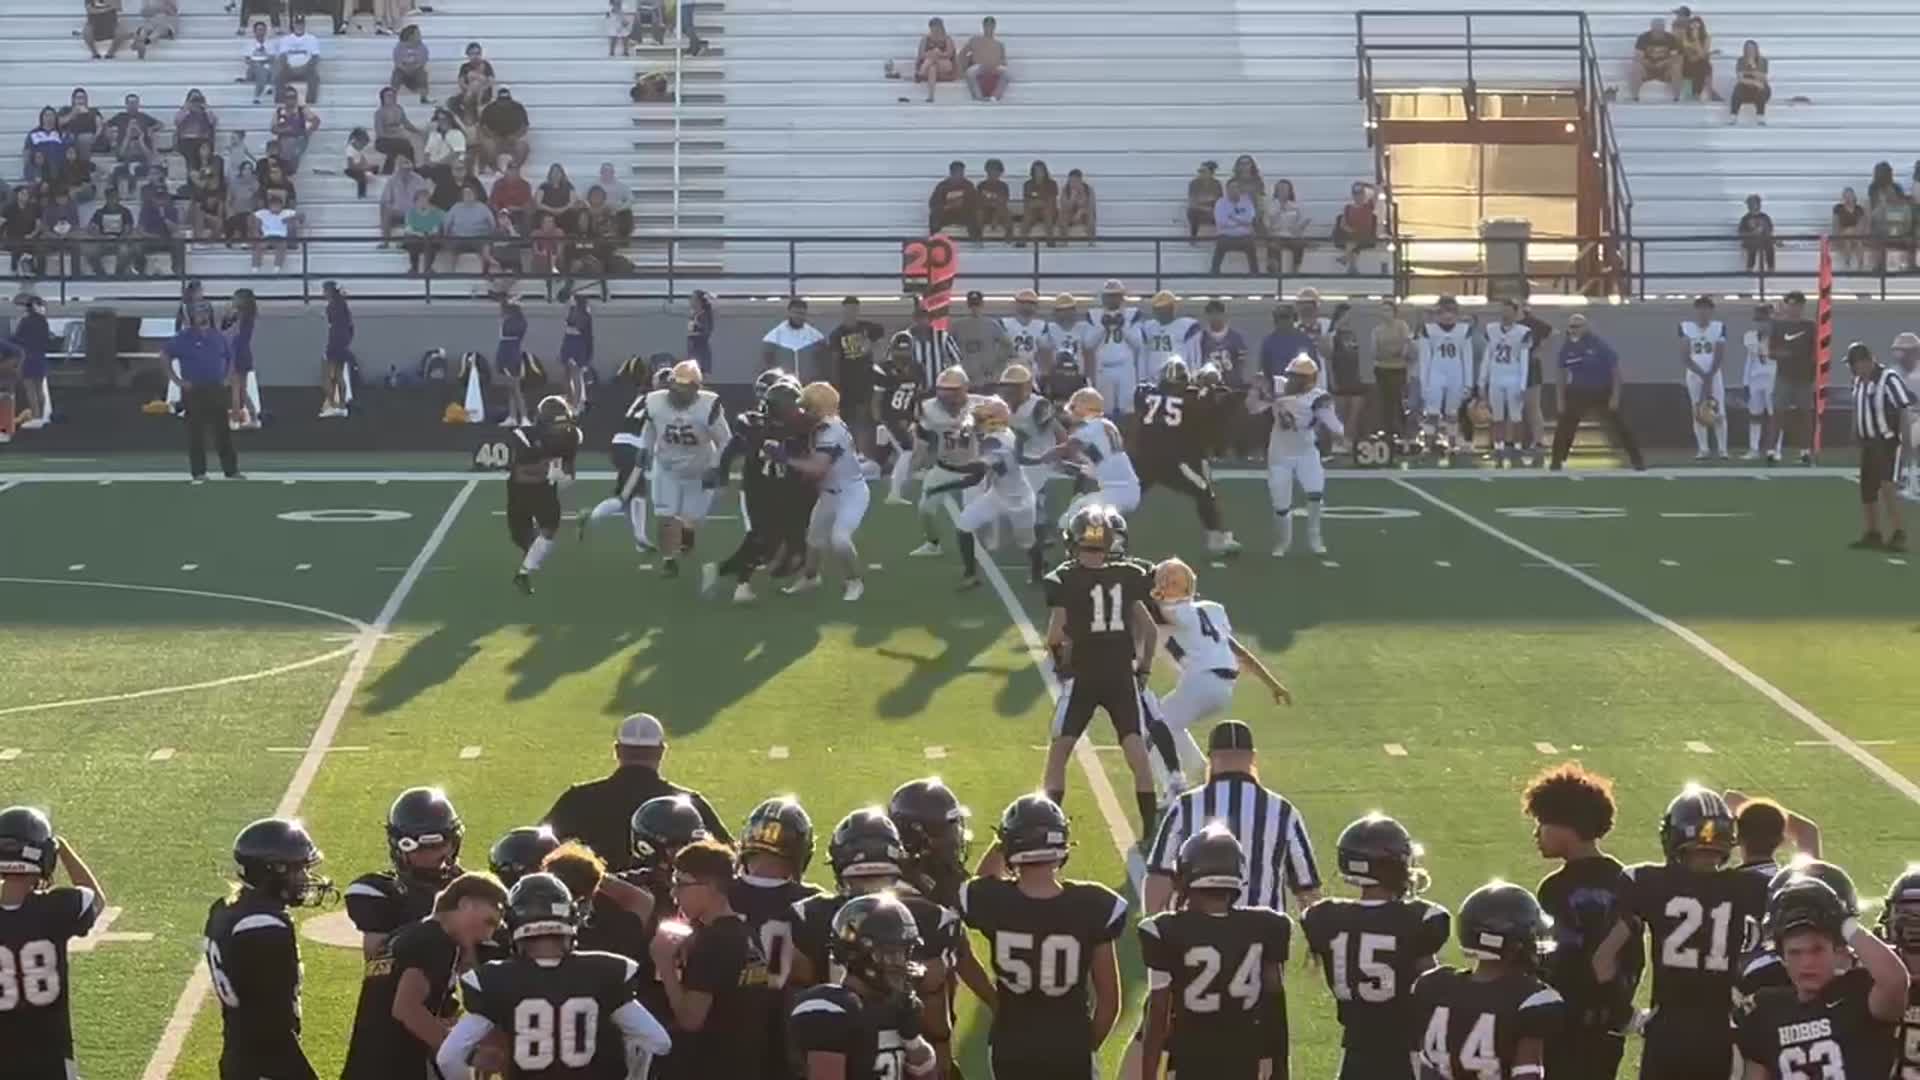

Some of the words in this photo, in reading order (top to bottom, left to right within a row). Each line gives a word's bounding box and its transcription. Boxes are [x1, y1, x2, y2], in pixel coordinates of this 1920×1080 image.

[1144, 395, 1183, 426] 75
[475, 443, 509, 468] 40
[1357, 441, 1391, 465] 30
[1090, 583, 1126, 633] 11
[1197, 607, 1221, 644] 4
[1700, 820, 1714, 843] 4
[1662, 896, 1732, 972] 21
[996, 930, 1081, 997] 50
[1183, 942, 1263, 1014] 24
[1329, 931, 1397, 1013] 15
[513, 997, 602, 1069] 80
[1424, 1005, 1502, 1080] 44
[1777, 1018, 1832, 1047] HOBBS
